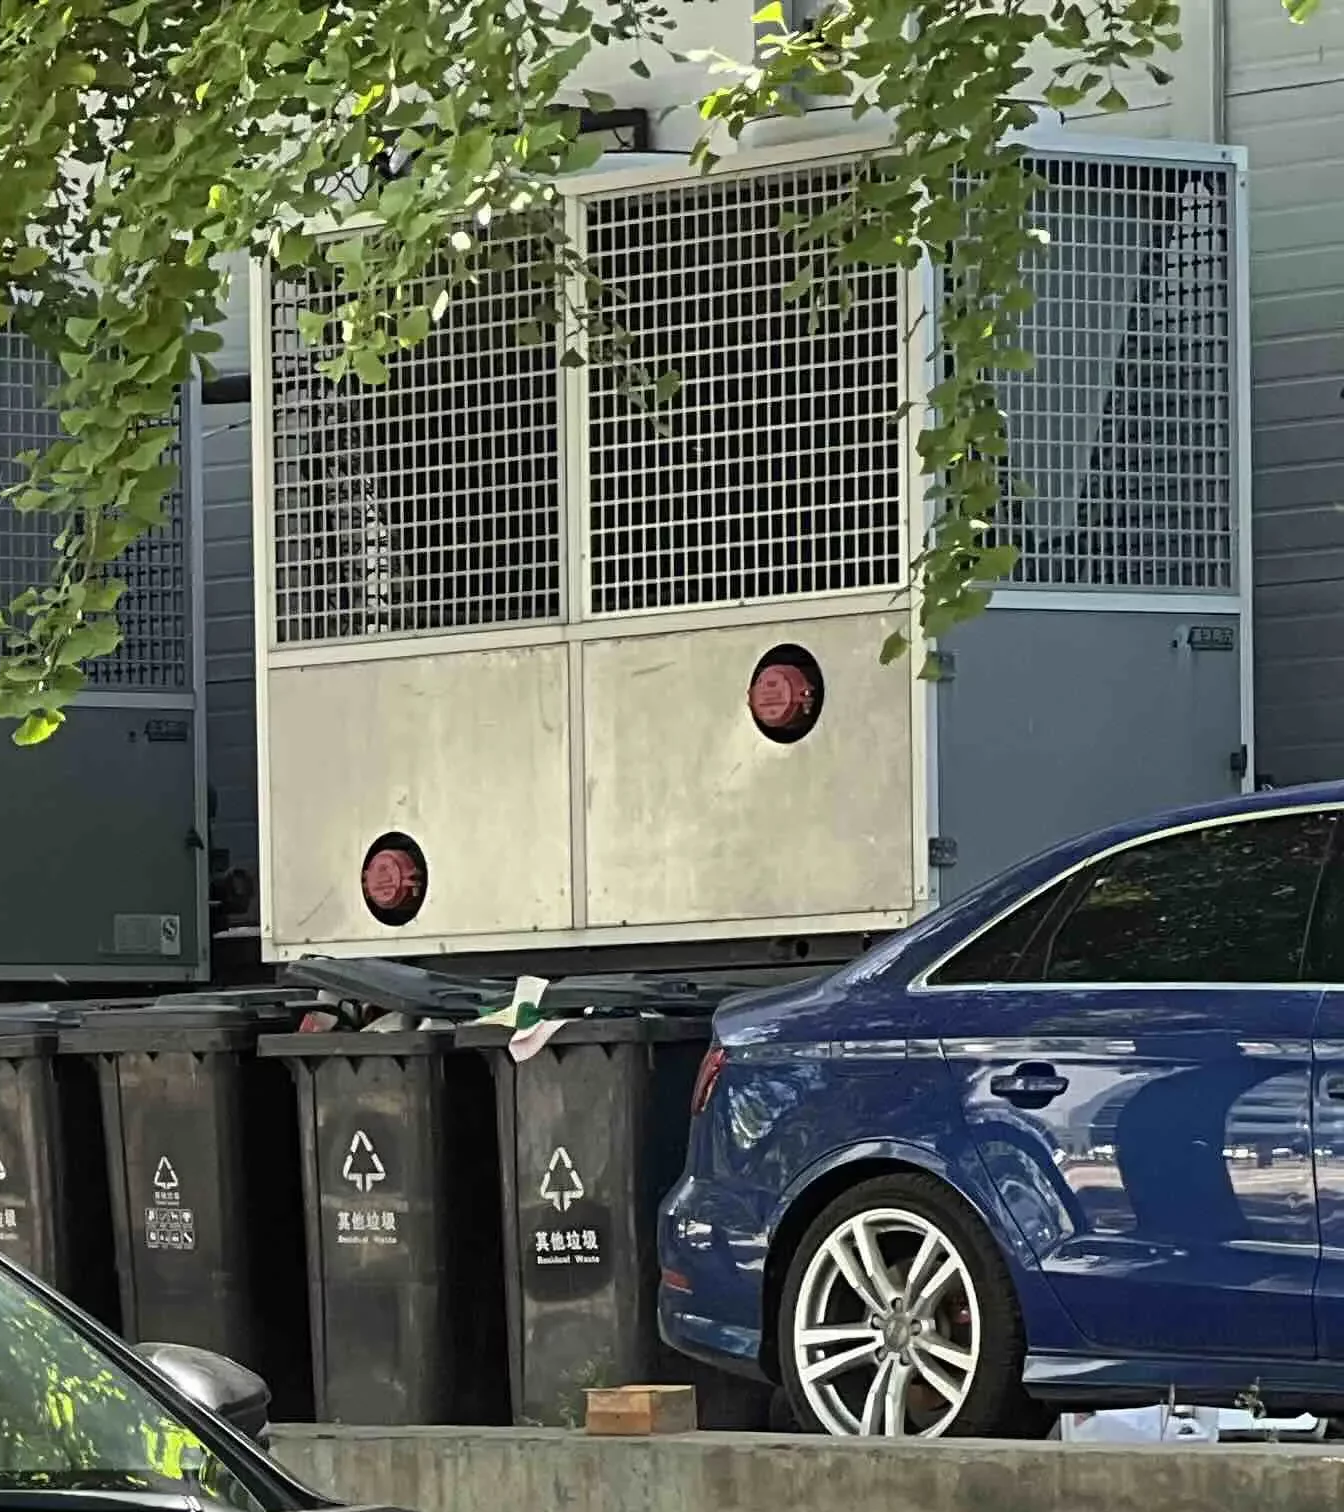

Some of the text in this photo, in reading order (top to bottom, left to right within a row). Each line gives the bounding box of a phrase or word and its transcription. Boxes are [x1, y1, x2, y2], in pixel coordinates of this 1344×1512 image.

[337, 1210, 396, 1231] 其他垃圾
[535, 1229, 599, 1252] 其他垃圾
[537, 1254, 601, 1265] Residual Waste
